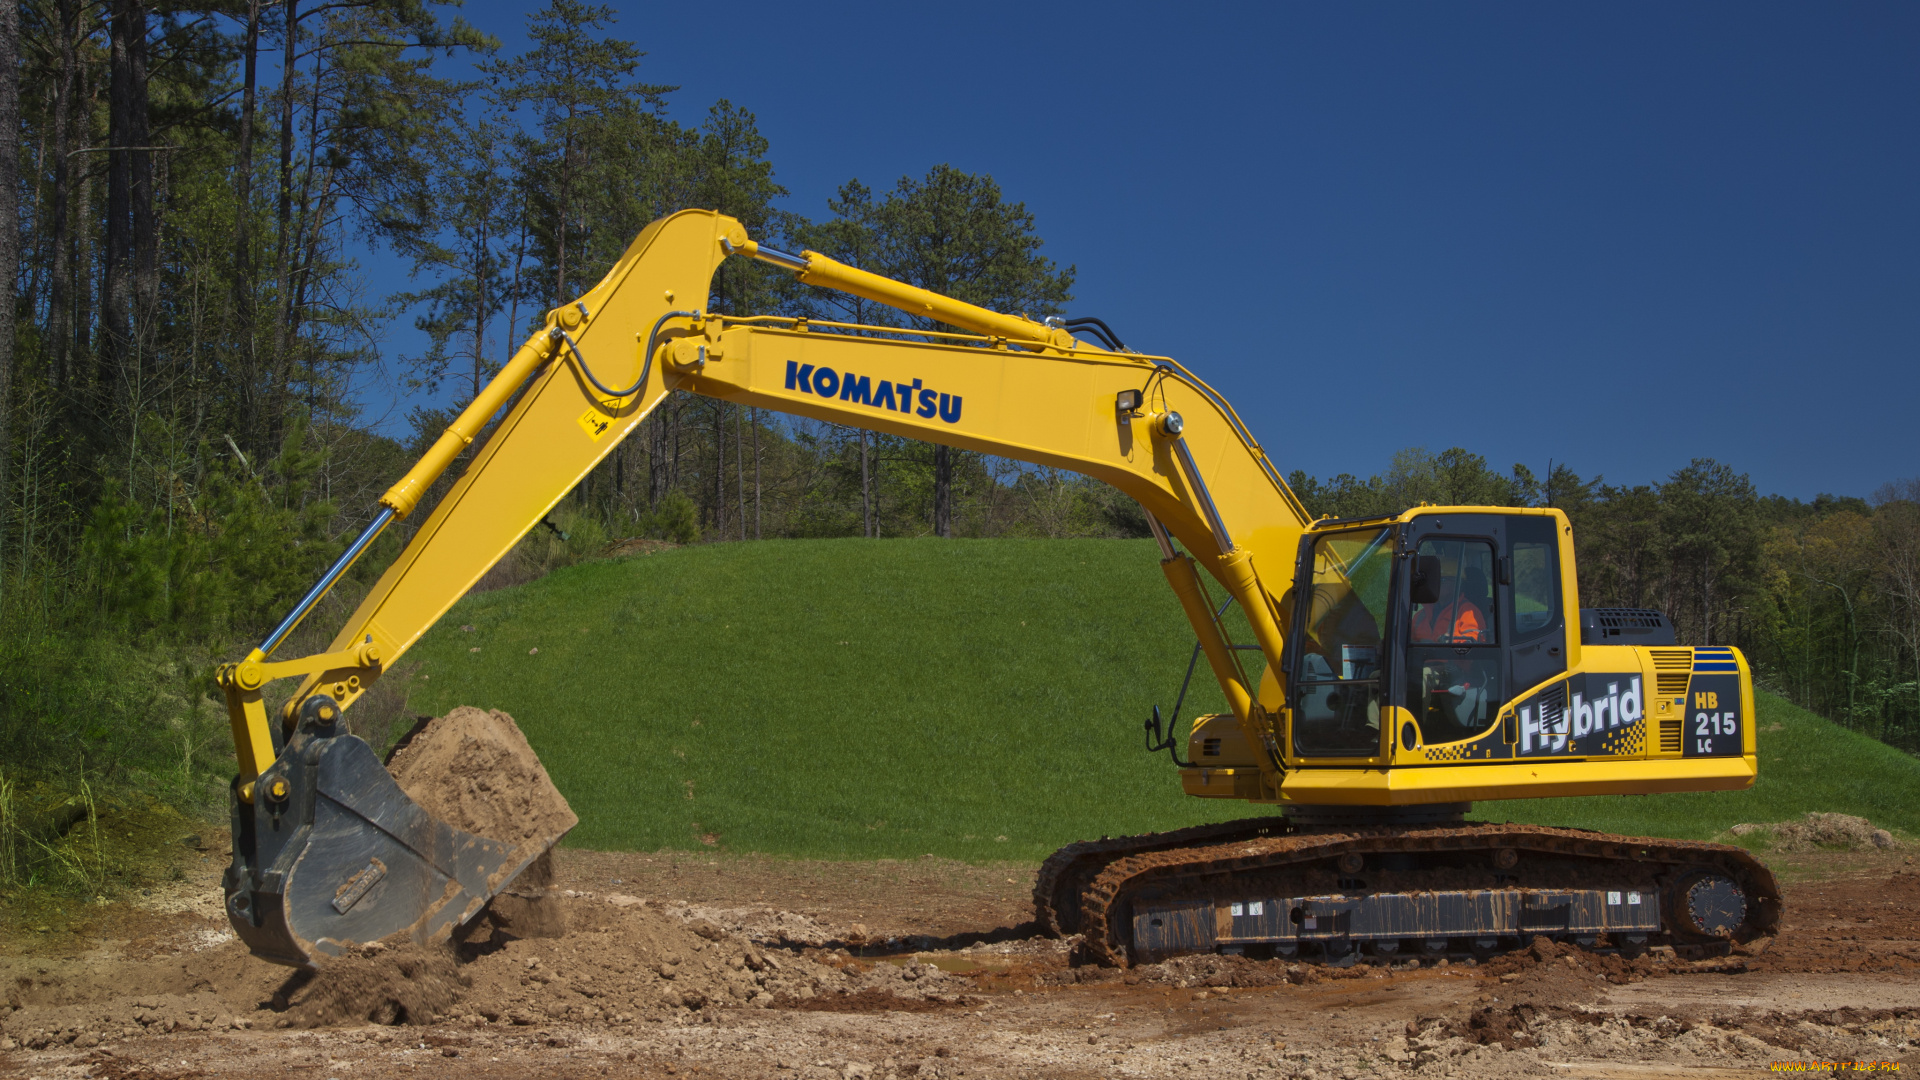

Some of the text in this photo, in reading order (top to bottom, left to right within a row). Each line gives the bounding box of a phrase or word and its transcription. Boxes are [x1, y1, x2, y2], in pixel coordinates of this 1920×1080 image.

[785, 360, 962, 424] KOMATSU
[1695, 692, 1718, 709] HB
[1520, 676, 1642, 753] Hybrid
[1696, 712, 1736, 735] 215
[1697, 739, 1712, 753] LC
